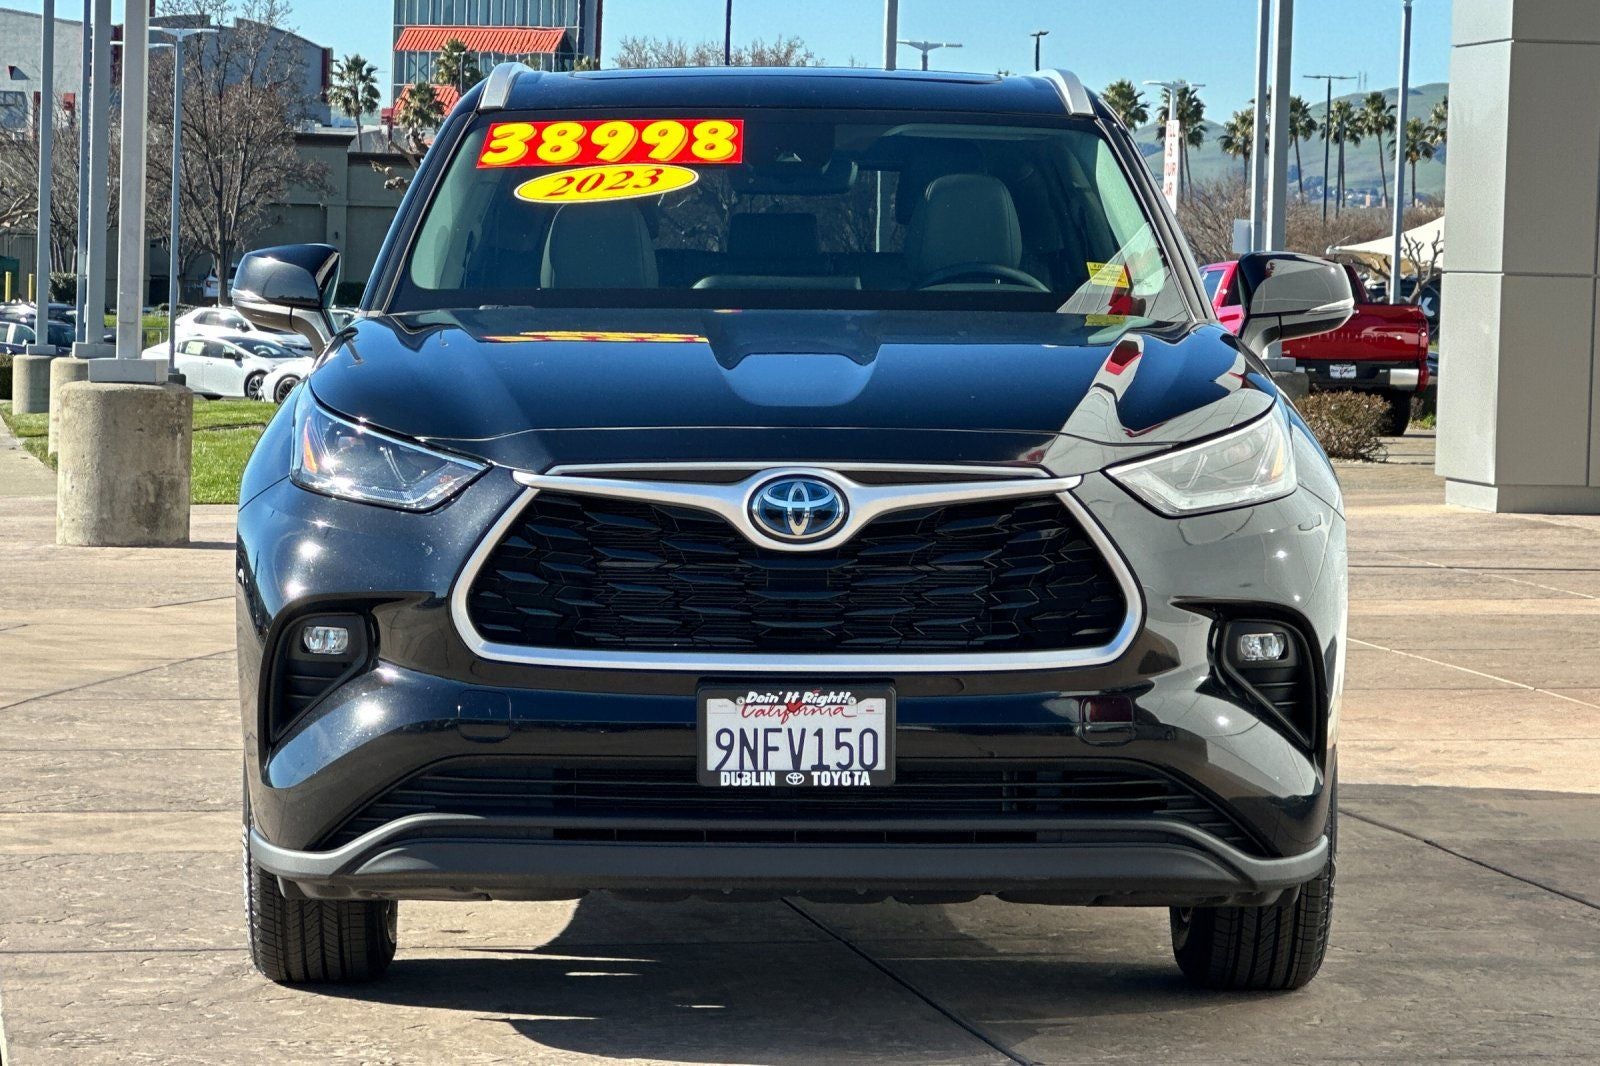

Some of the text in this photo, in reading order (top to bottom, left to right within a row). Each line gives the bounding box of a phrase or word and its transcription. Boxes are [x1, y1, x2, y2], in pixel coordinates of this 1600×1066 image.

[481, 120, 738, 164] 38998
[544, 168, 664, 197] 2023
[746, 691, 851, 707] Doin' It Right!
[741, 702, 857, 724] California
[715, 728, 879, 770] 9NFV150
[721, 771, 871, 786] DUBLIN TOYOTA
